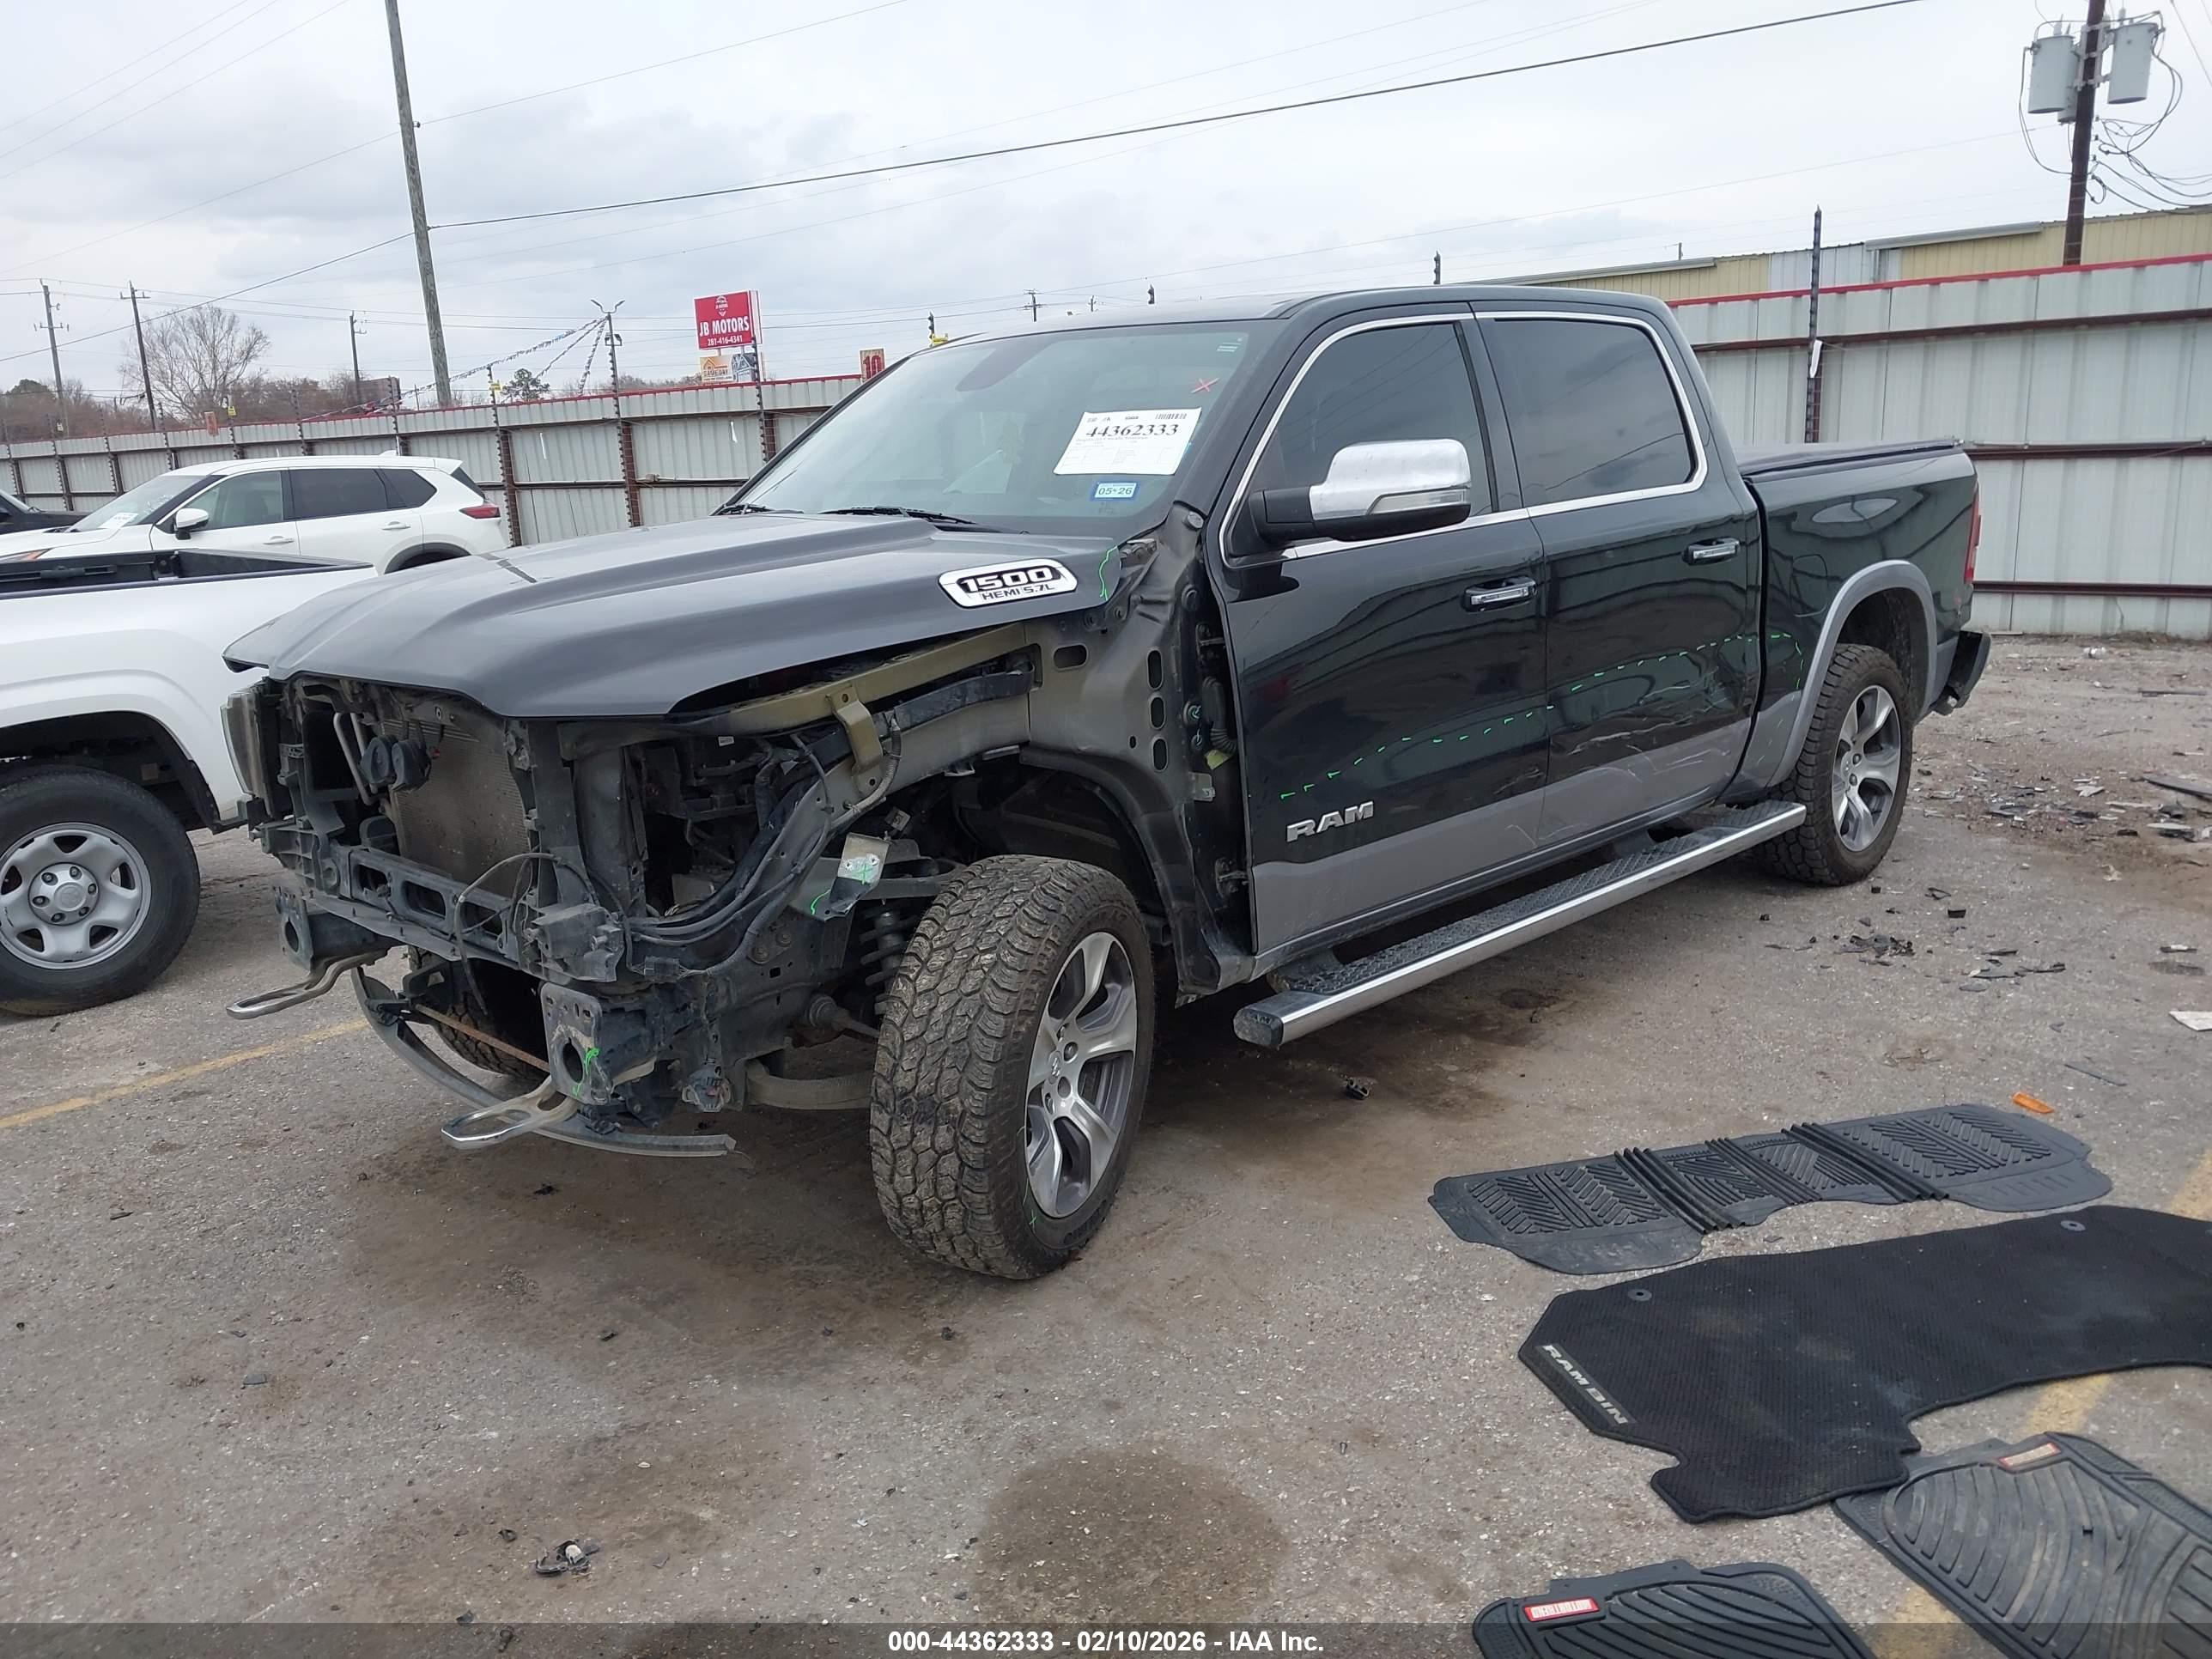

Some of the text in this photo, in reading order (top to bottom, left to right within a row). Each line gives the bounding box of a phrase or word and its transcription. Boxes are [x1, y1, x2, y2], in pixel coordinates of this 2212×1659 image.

[699, 315, 750, 337] JB MOTORS
[707, 334, 743, 347] 281-416-4341
[1086, 423, 1179, 438] 44362333
[960, 567, 1054, 593] 1500
[981, 584, 1055, 601] HEMI 5.7L
[1286, 800, 1374, 842] RAM
[1542, 1345, 1590, 1386] RAM
